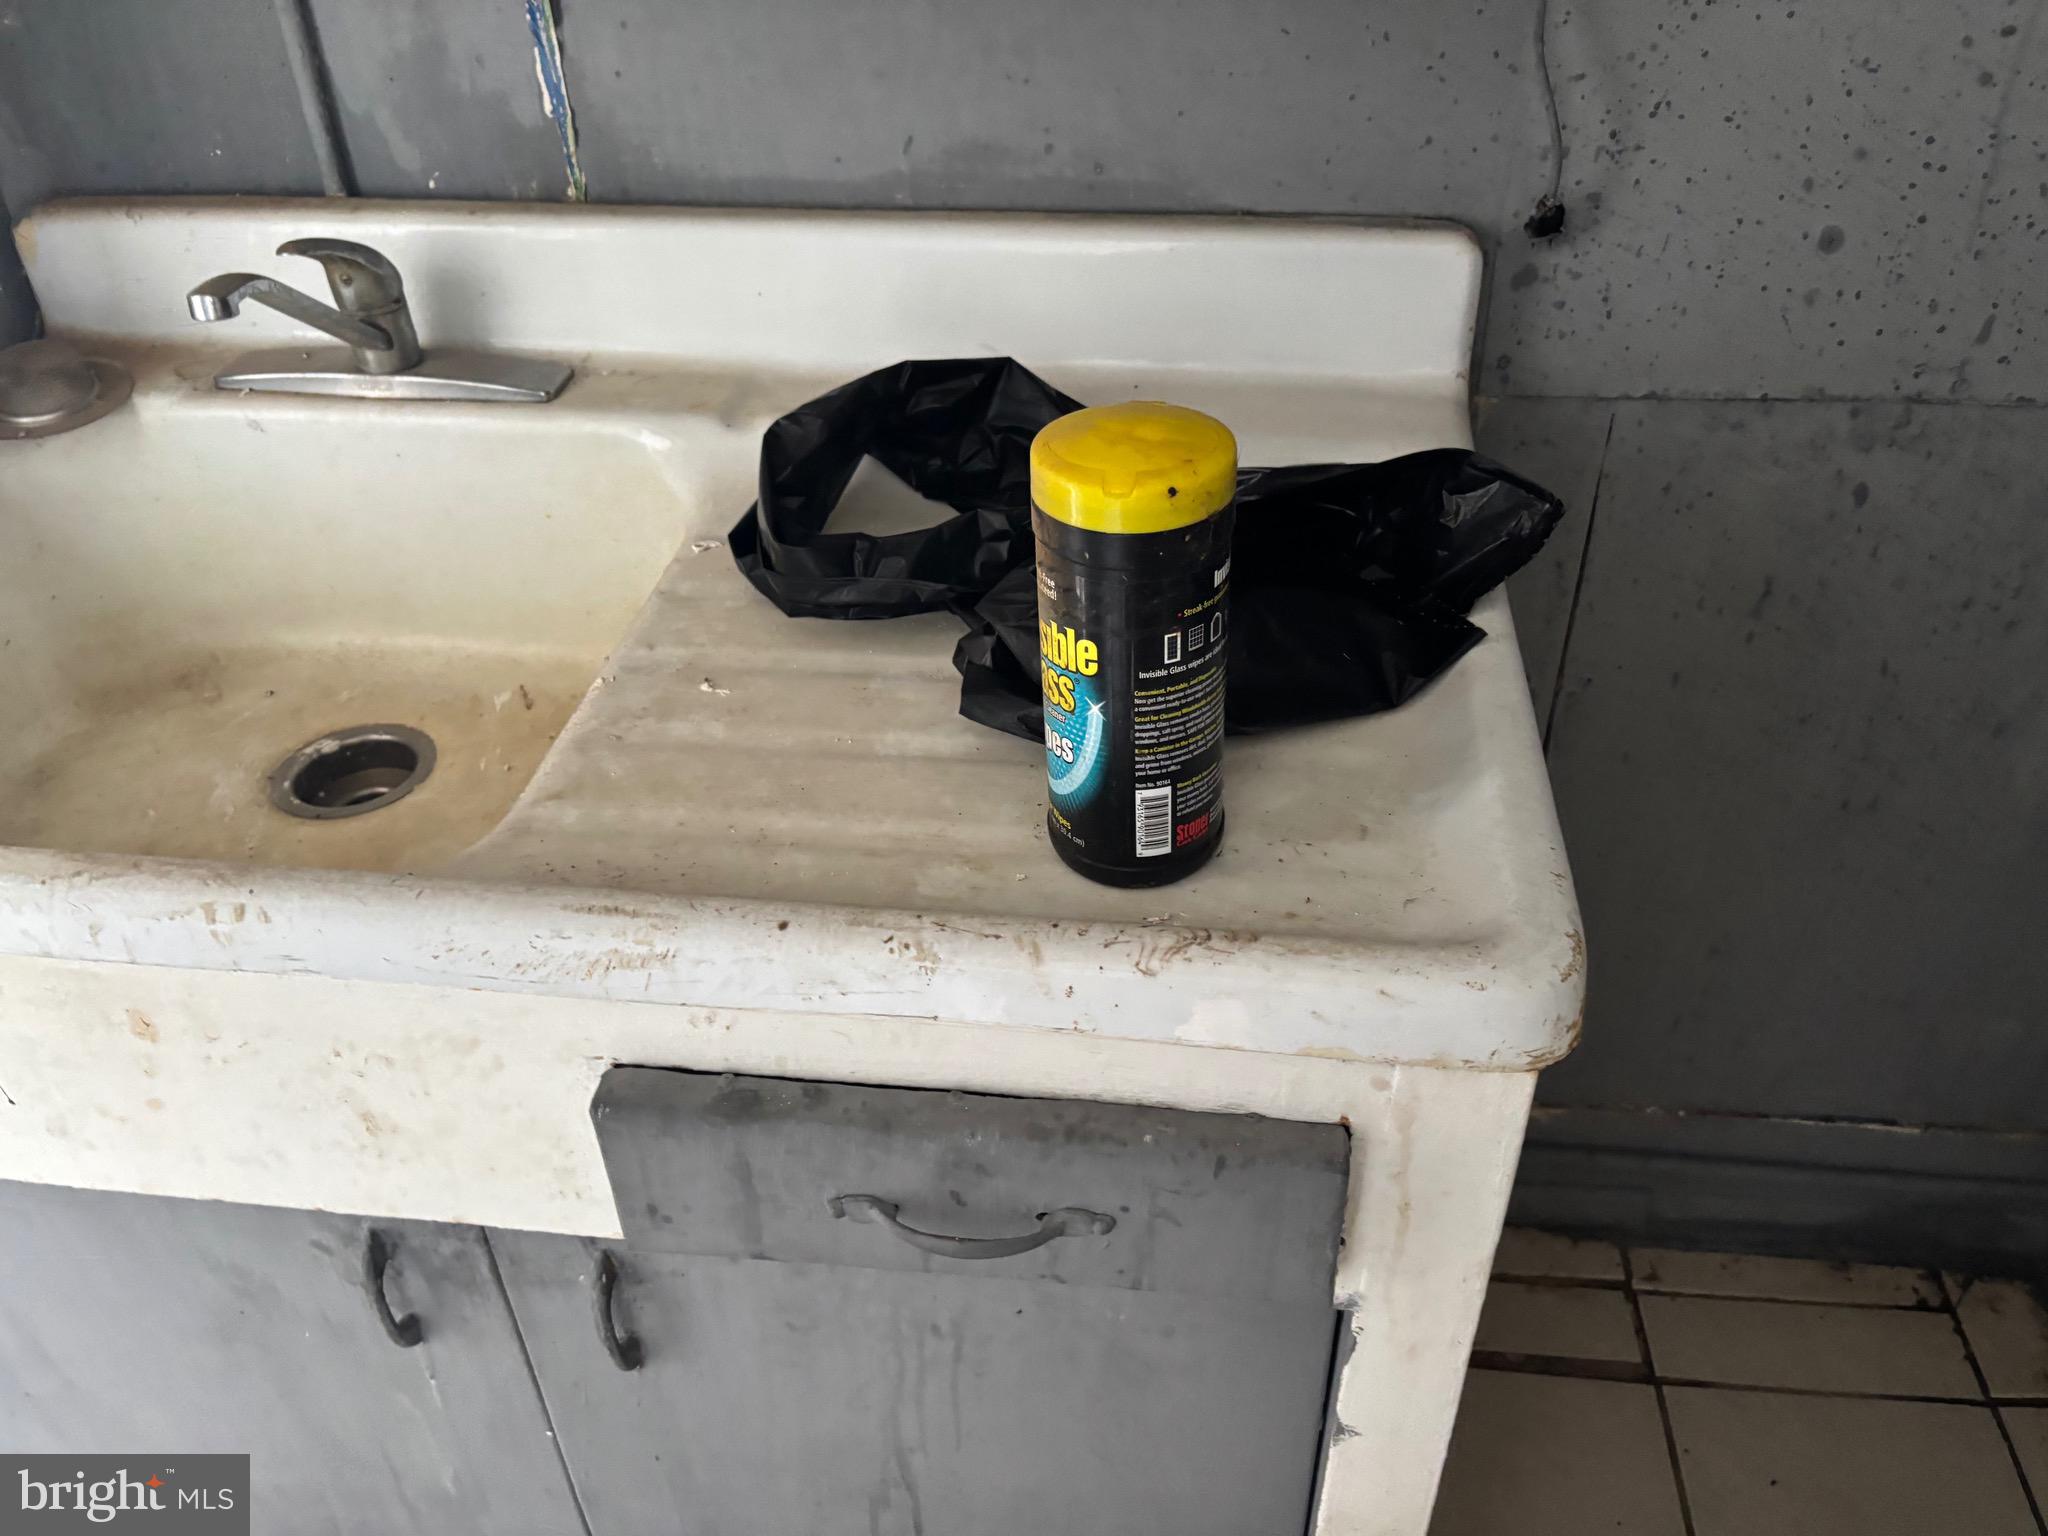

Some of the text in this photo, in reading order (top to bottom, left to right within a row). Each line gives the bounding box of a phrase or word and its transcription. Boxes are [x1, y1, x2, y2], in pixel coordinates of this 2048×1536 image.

[1139, 669, 1168, 679] Invisible
[1169, 664, 1187, 675] Glass
[1188, 657, 1204, 668] wipes
[1156, 778, 1171, 787] 90164
